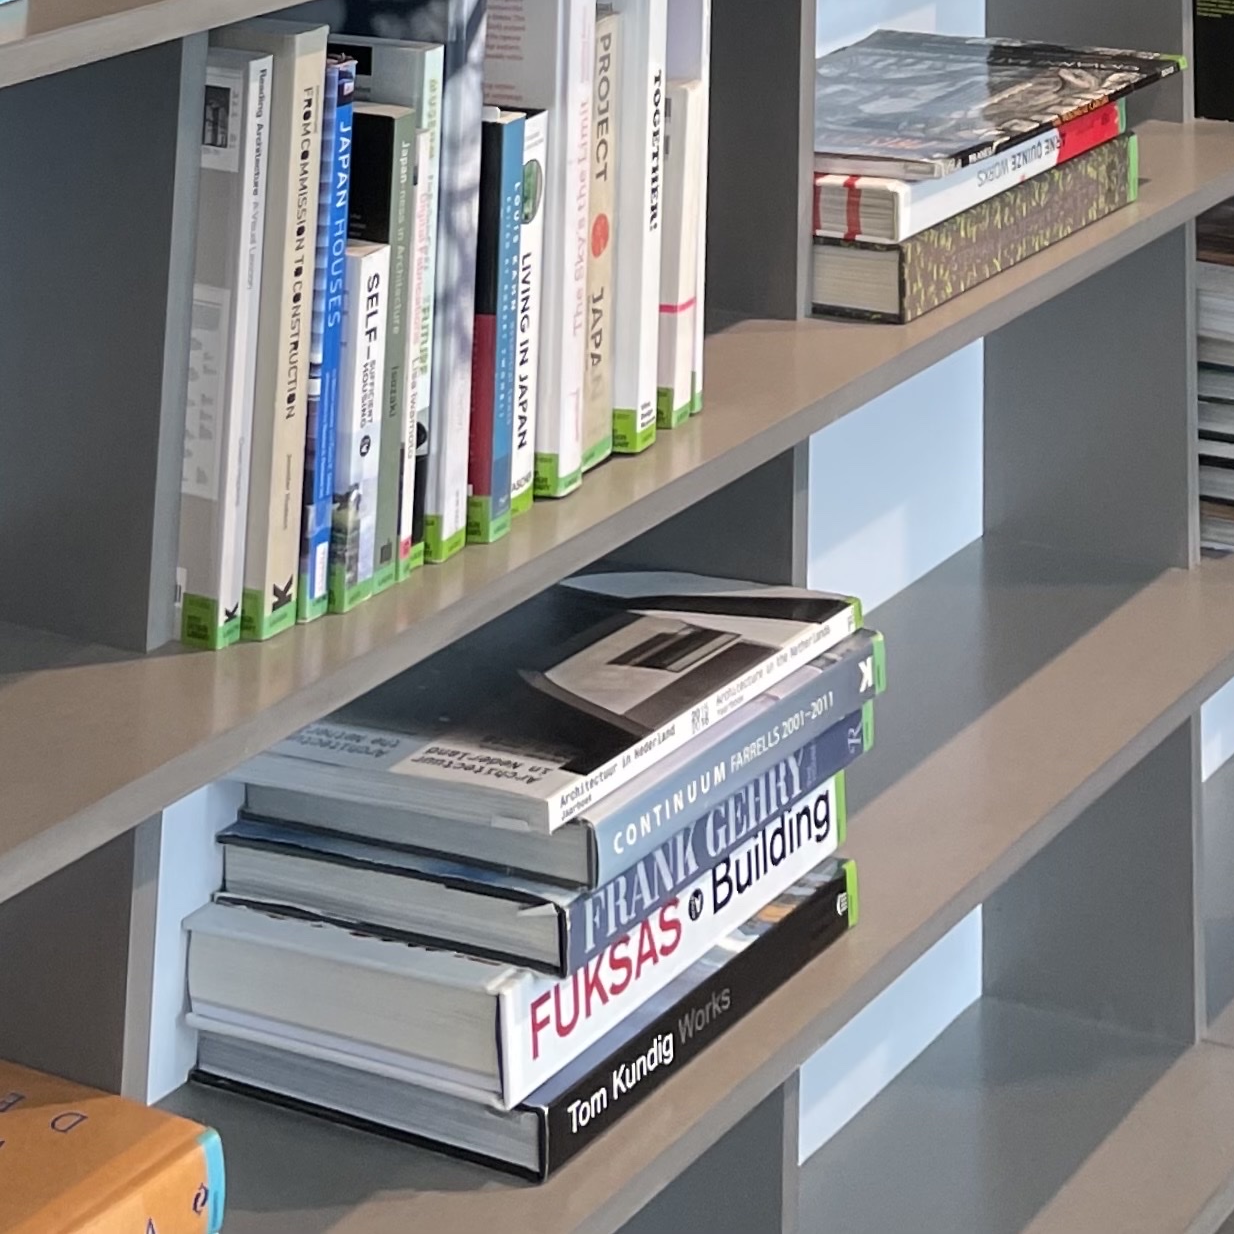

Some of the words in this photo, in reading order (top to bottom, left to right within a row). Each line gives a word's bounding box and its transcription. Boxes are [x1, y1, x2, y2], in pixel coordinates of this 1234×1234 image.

[255, 67, 268, 121] Reading
[301, 86, 314, 138] FROM
[594, 32, 612, 182] PROJECT
[251, 122, 265, 197] Architecture
[334, 120, 351, 208] JAPAN
[578, 99, 589, 165] Limit
[1010, 143, 1044, 172] QUINZE
[295, 139, 310, 252] COMMISSION
[397, 140, 410, 224] Japan-ness
[577, 171, 588, 214] the
[976, 157, 1010, 188] WORKS
[396, 227, 407, 241] in
[513, 181, 521, 244] LOUIS
[293, 254, 304, 278] TO
[327, 218, 345, 328] HOUSES
[392, 244, 407, 336] Architecture
[510, 254, 518, 312] KAHN
[519, 251, 533, 334] LIVING
[573, 282, 586, 337] The
[284, 278, 302, 421] CONSTRUCTION
[410, 357, 420, 391] Lisa
[518, 339, 530, 367] IN
[359, 362, 369, 430] HOUSING
[366, 358, 377, 424] SUFFICIENT
[388, 365, 400, 419] Isozaki
[516, 372, 530, 450] JAPAN
[406, 390, 418, 460] Iwamoto
[410, 755, 543, 785] Architectuur
[426, 746, 521, 771] Nederland
[559, 760, 618, 810] Architectuur
[621, 747, 632, 765] in
[633, 724, 677, 762] Nederland
[612, 760, 729, 856] CONTINUUM
[729, 725, 781, 775] FARRELLS
[584, 829, 702, 955] FRANK
[704, 745, 804, 860] GEHRY
[529, 895, 683, 1060] FUKSAS
[711, 788, 831, 916] Building
[567, 1085, 609, 1134] Tom
[611, 1031, 675, 1101] Kundig
[678, 985, 733, 1045] Works
